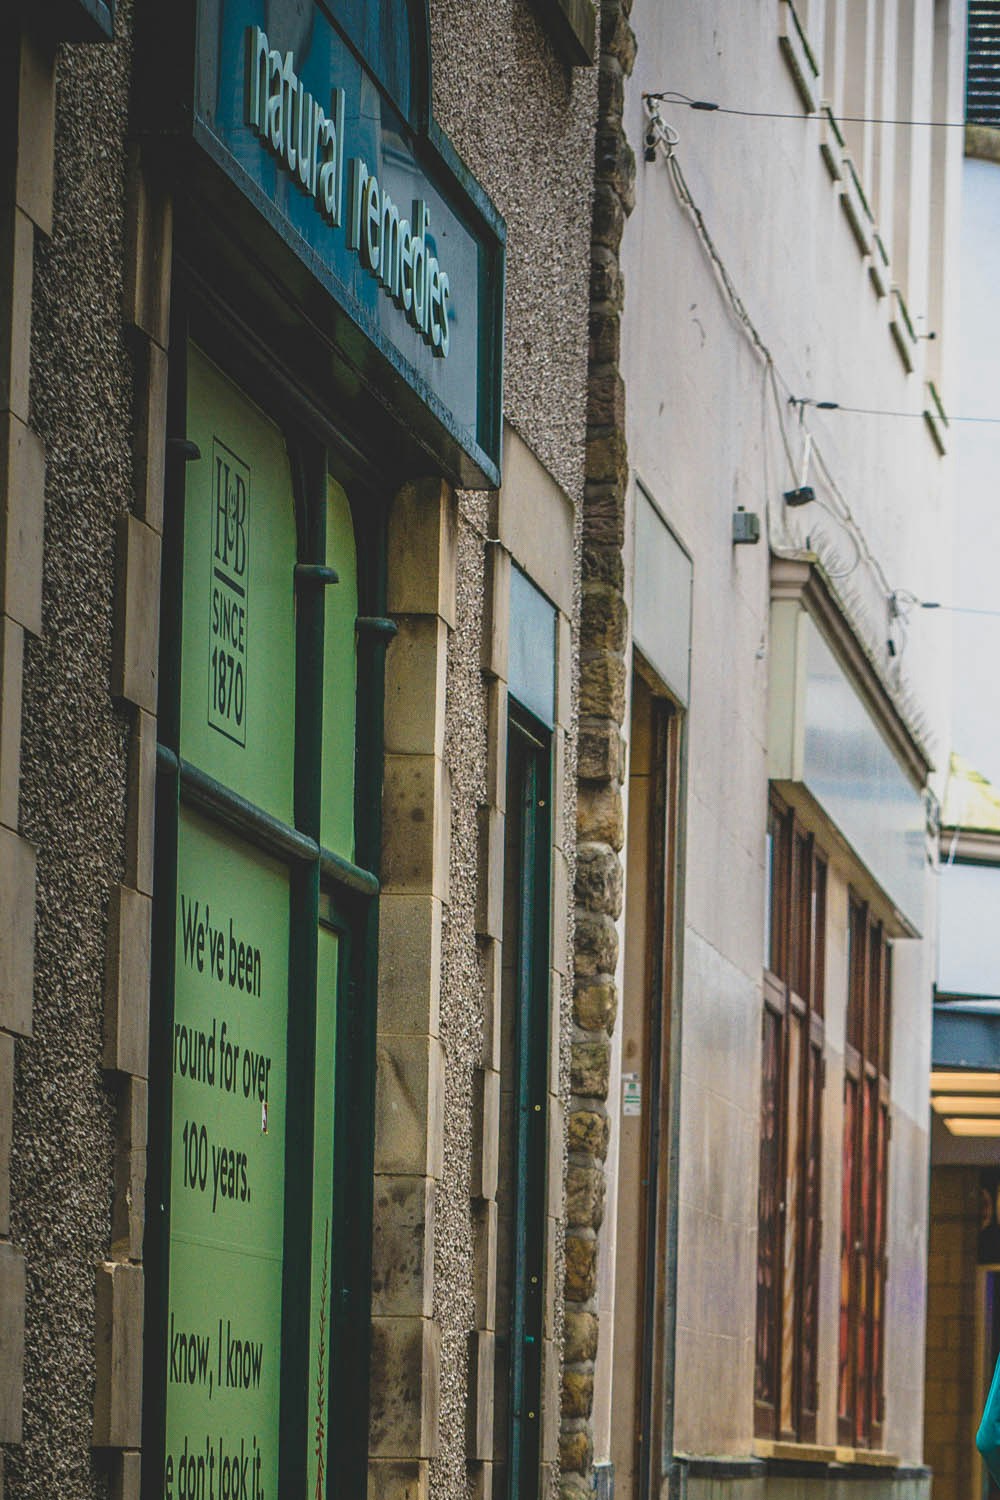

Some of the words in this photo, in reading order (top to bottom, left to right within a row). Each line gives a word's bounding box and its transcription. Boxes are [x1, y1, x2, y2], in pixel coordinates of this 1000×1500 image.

[244, 25, 345, 228] natural
[346, 158, 449, 358] remedies
[212, 588, 245, 654] SINCE
[211, 644, 243, 727] 1870
[181, 894, 225, 983] We've
[228, 917, 262, 998] been
[174, 1018, 216, 1088] round
[220, 1021, 239, 1093] for
[243, 1048, 271, 1103] over
[183, 1120, 207, 1192] 100
[212, 1144, 251, 1214] years.
[169, 1312, 212, 1399] know,
[226, 1319, 263, 1389] know
